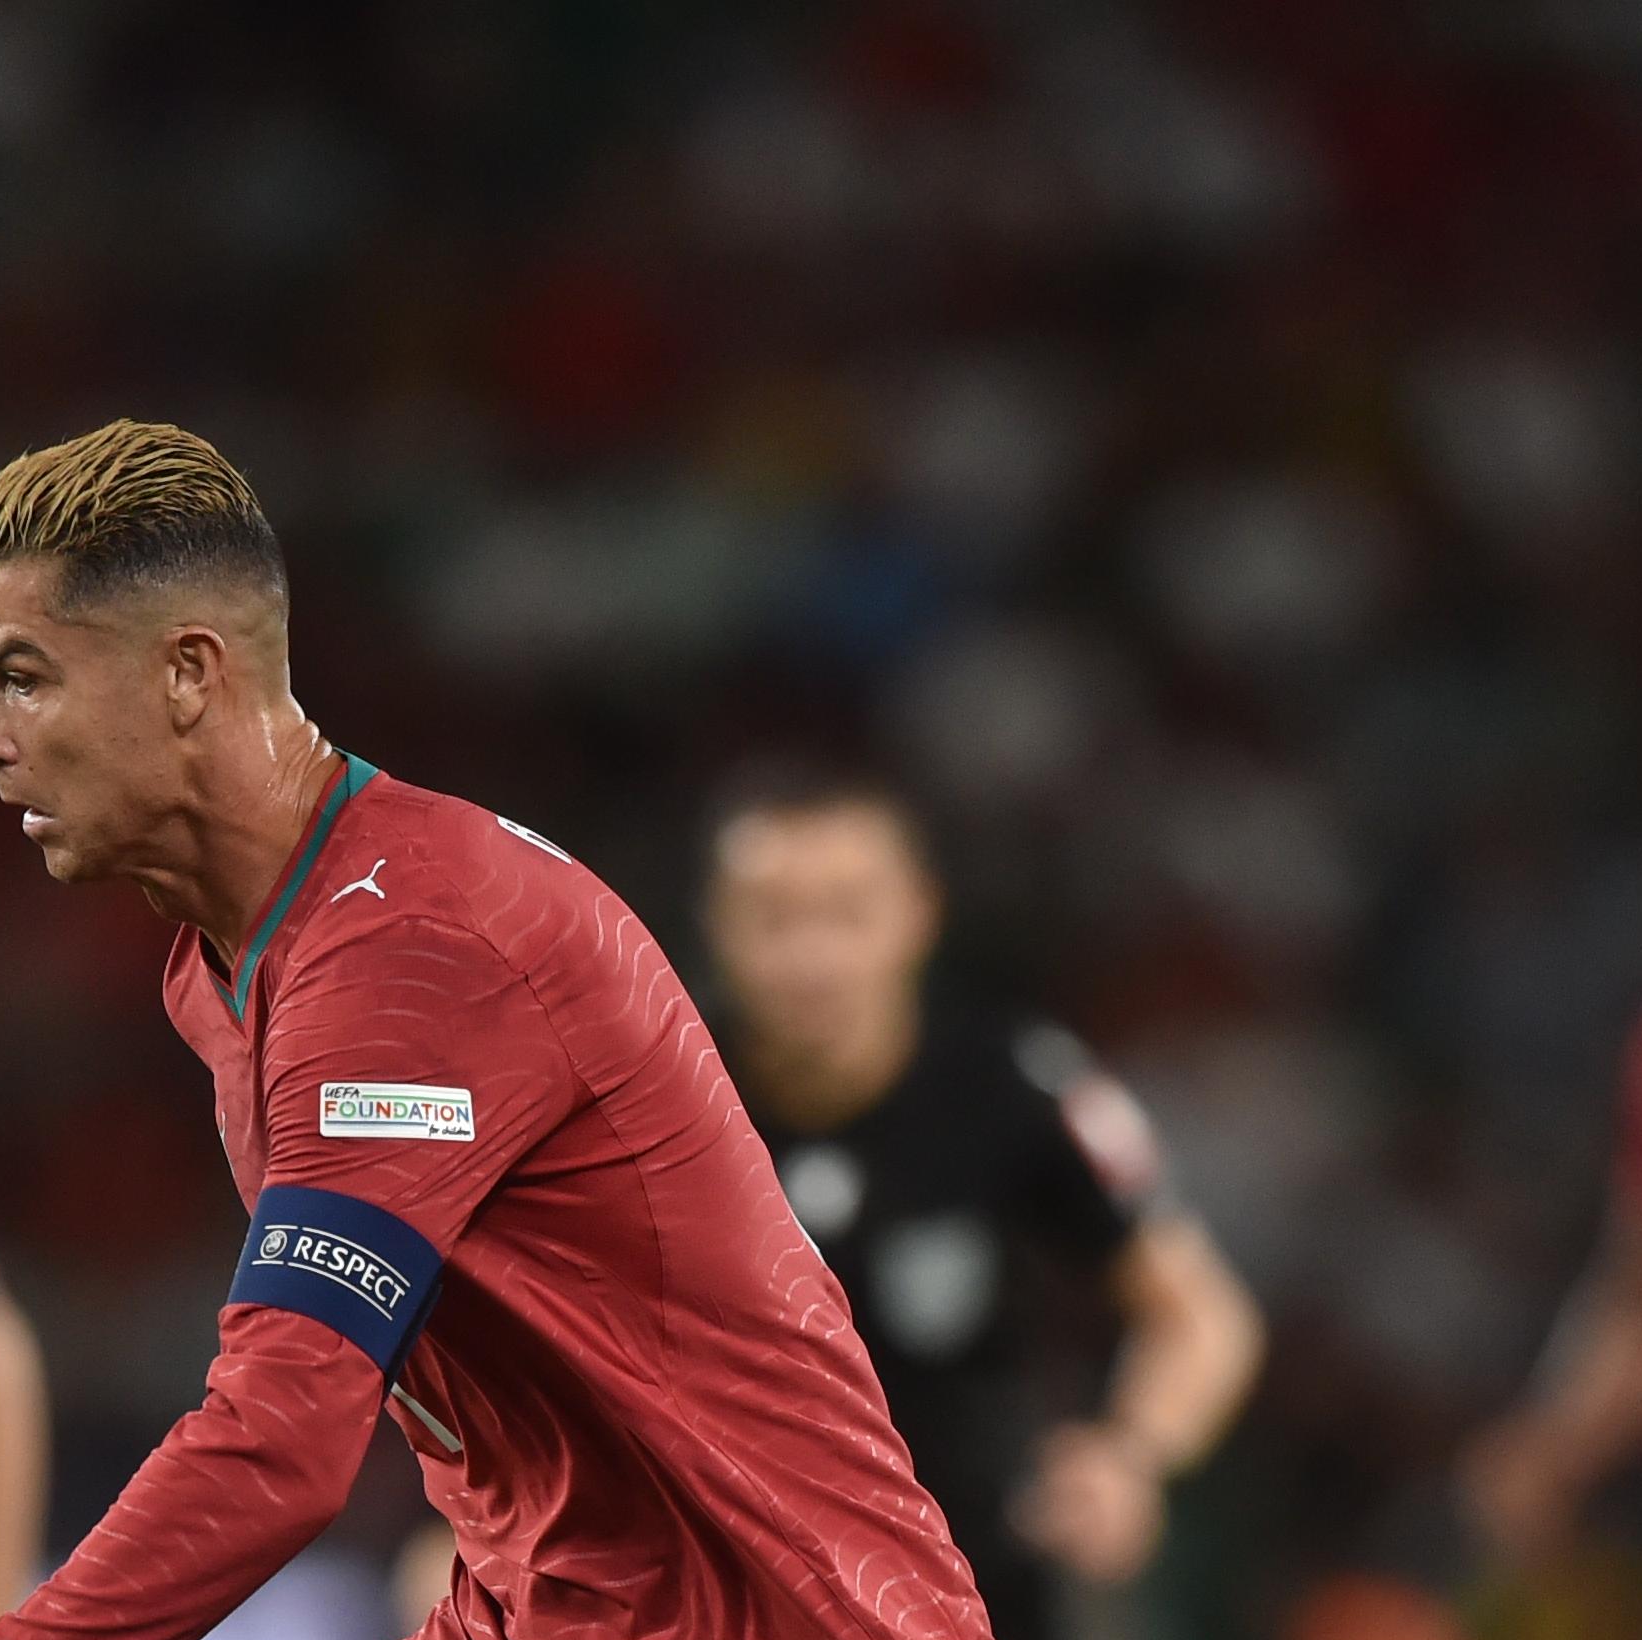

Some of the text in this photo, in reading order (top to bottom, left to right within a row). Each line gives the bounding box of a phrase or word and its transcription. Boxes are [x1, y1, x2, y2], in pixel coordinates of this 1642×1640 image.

[324, 1086, 360, 1099] UEFA
[324, 1100, 470, 1123] FOUNDATION
[429, 1124, 440, 1137] for
[292, 1235, 406, 1309] RESPECT
